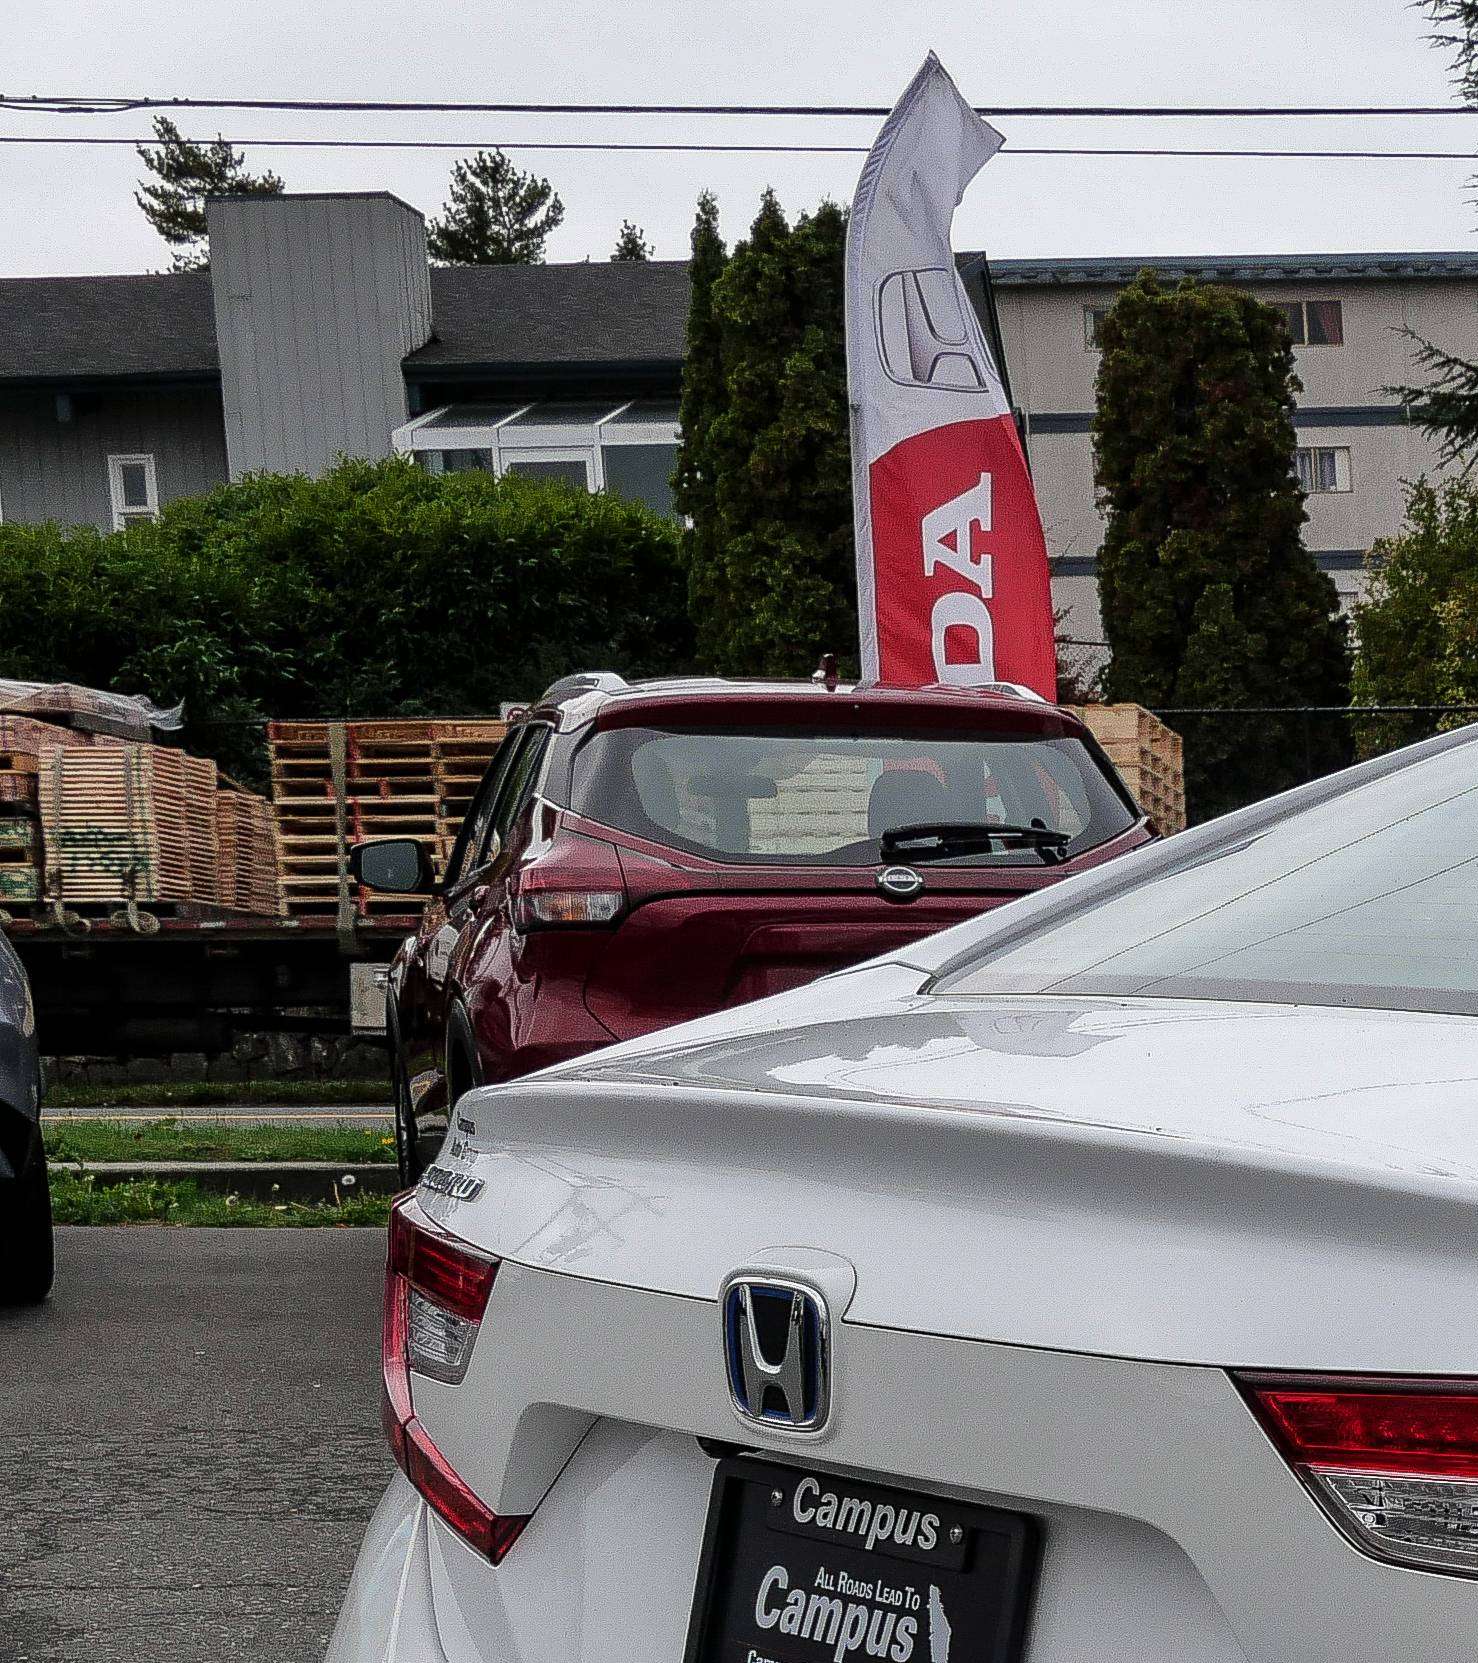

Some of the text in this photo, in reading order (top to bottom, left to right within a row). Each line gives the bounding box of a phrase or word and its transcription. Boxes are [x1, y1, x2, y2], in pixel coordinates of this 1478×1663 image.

[793, 1477, 940, 1550] Campus
[755, 1565, 918, 1663] Campus
[814, 1566, 835, 1591] ALL
[837, 1571, 874, 1599] ROADS
[875, 1580, 904, 1606] LEAD
